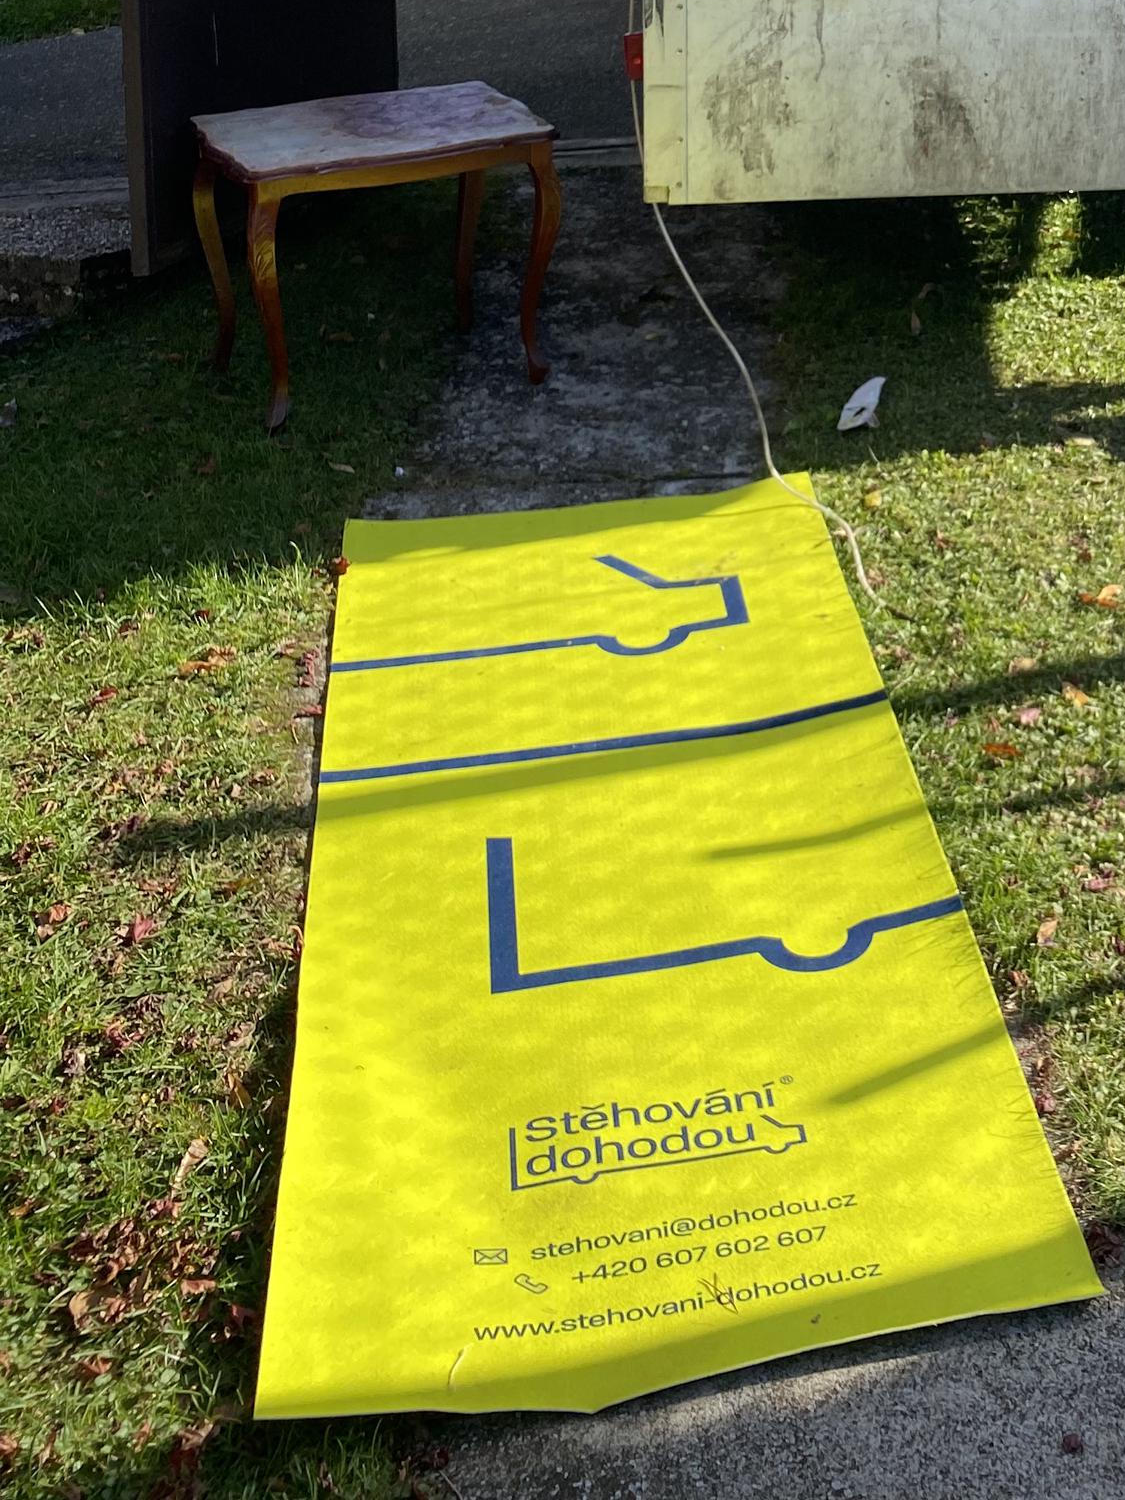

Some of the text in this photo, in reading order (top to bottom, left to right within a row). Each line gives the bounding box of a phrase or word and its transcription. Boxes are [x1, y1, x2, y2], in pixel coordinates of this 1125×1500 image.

[526, 1122, 755, 1176] dohodou
[530, 1193, 858, 1260] stehovani@dohodou.cz
[572, 1225, 827, 1284] +420 607 602 607
[474, 1263, 883, 1341] www.stehovani-dohodou.cz
